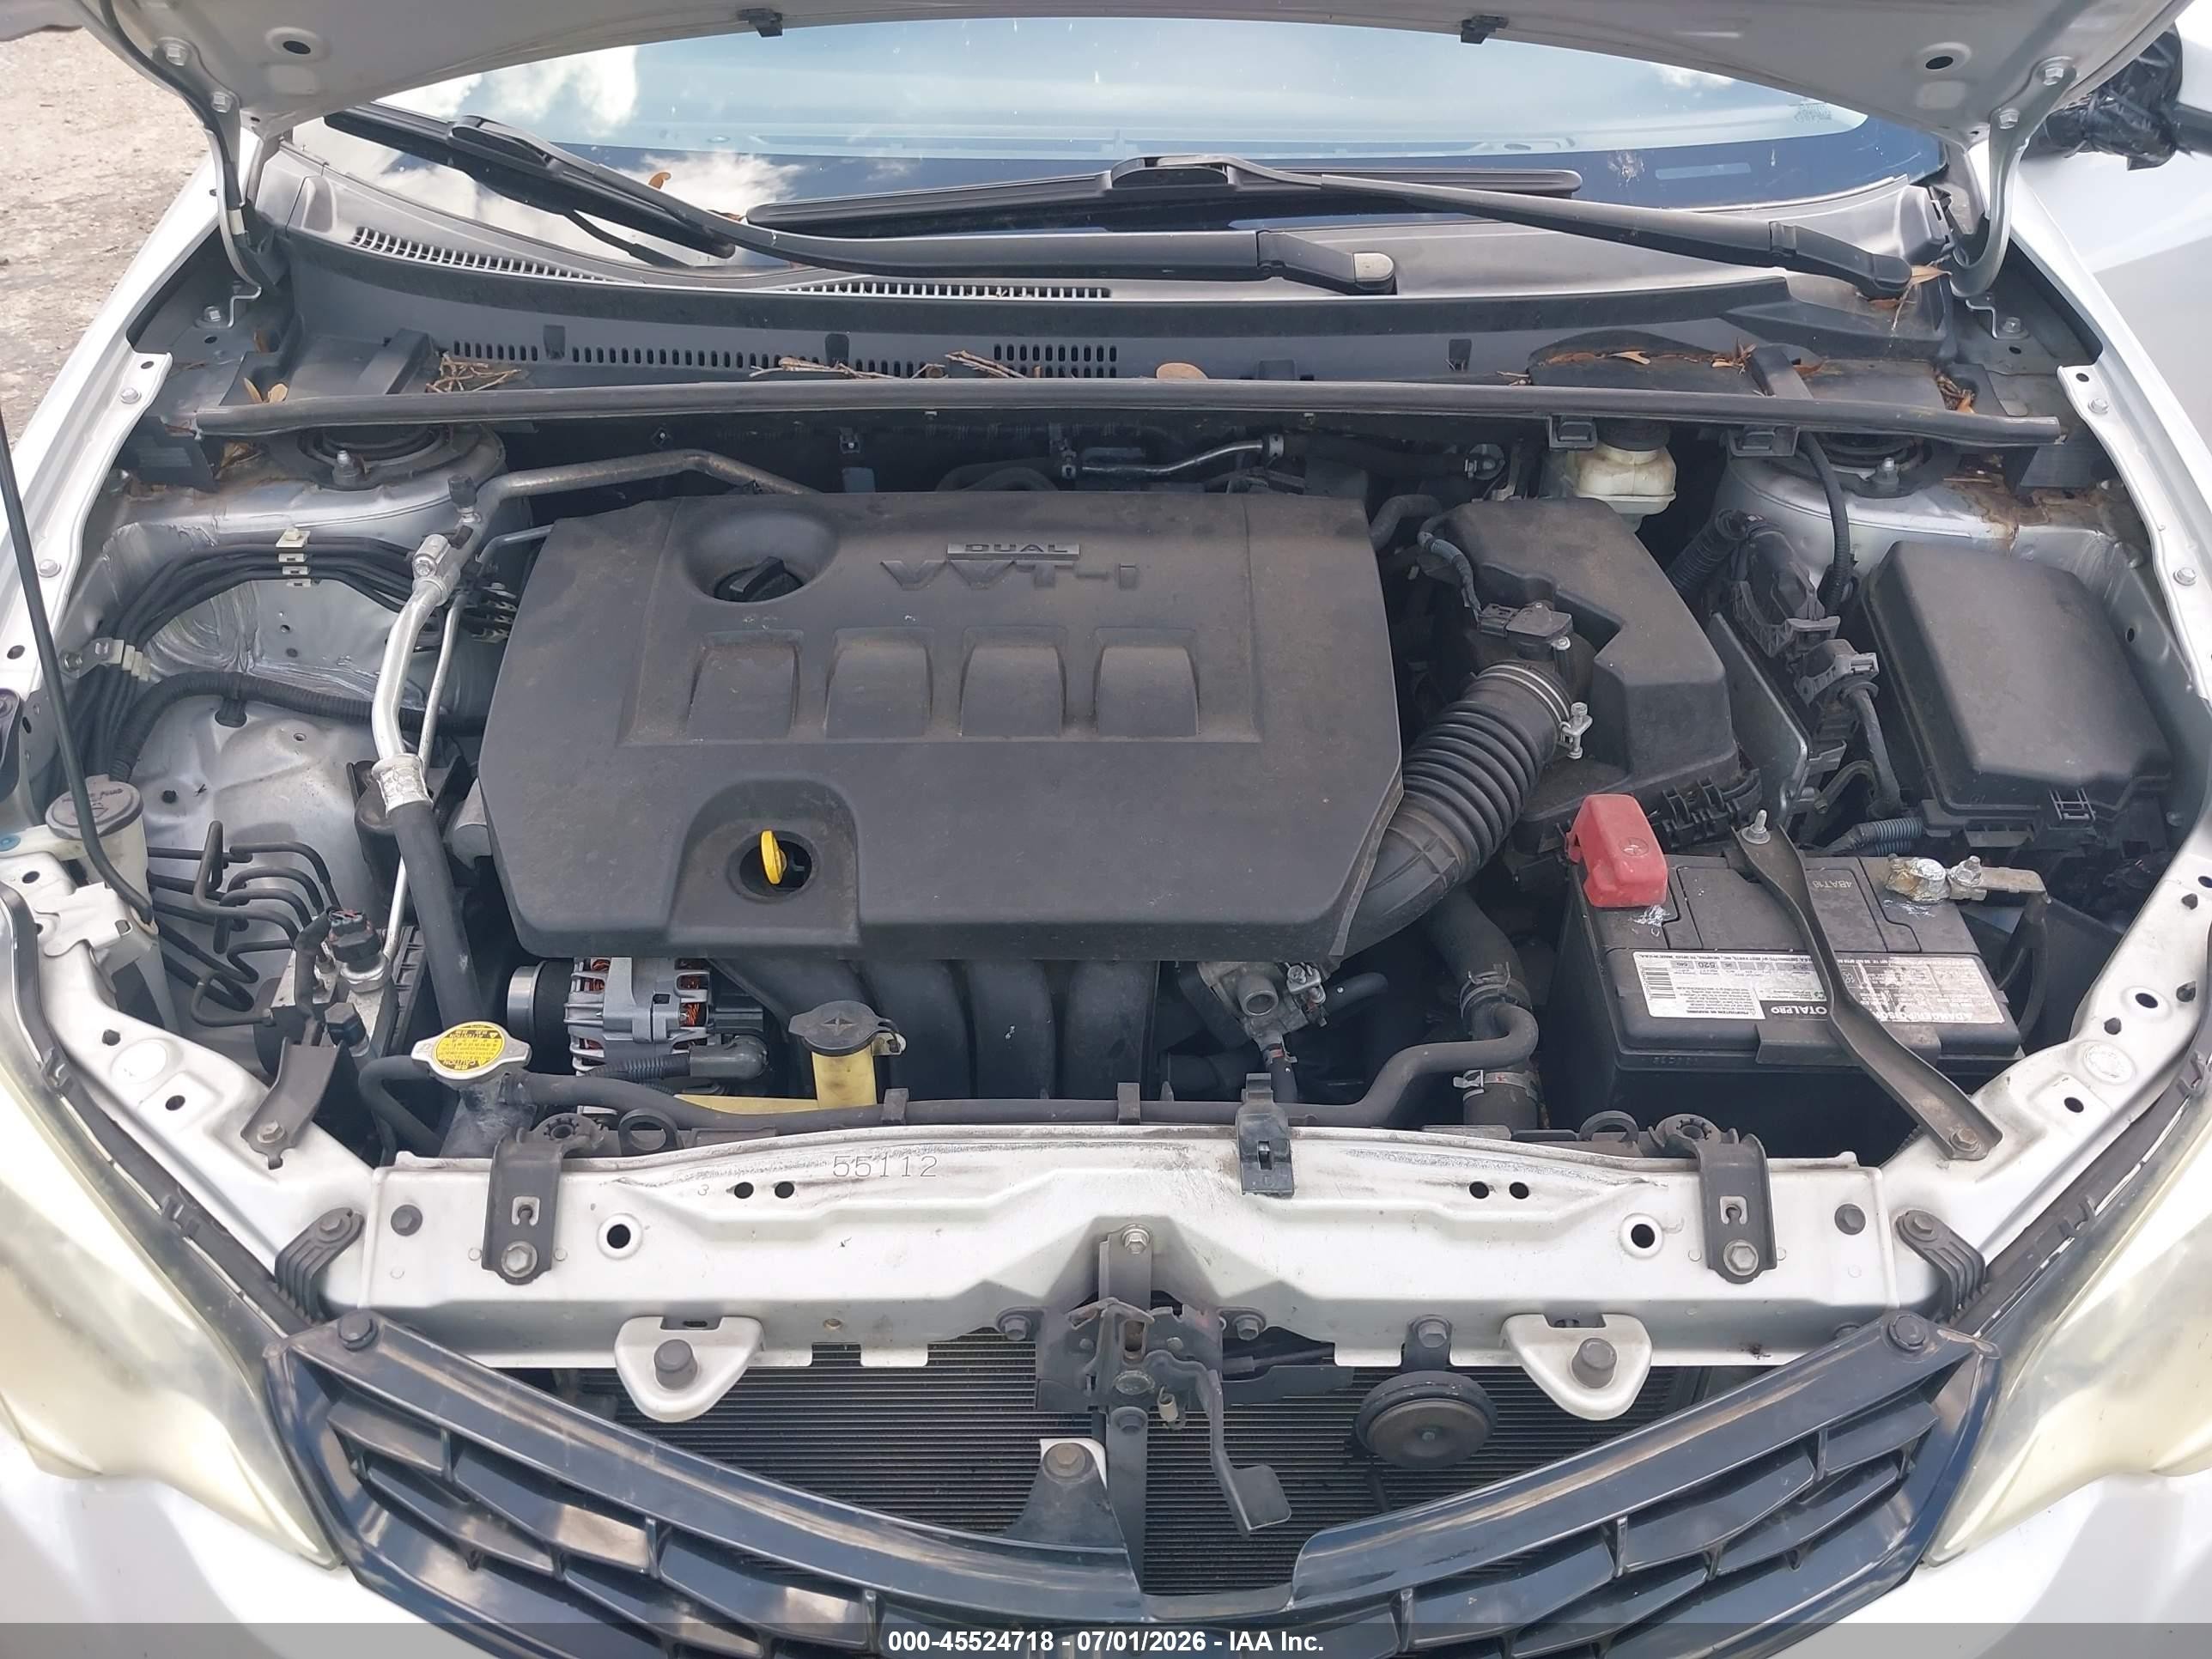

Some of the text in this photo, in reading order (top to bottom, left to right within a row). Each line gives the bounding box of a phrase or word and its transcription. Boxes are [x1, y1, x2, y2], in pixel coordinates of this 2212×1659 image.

[964, 544, 1068, 553] DUAL
[1698, 961, 1716, 969] 520
[1771, 1005, 1828, 1016] OTALPRO
[832, 1155, 939, 1178] 55112
